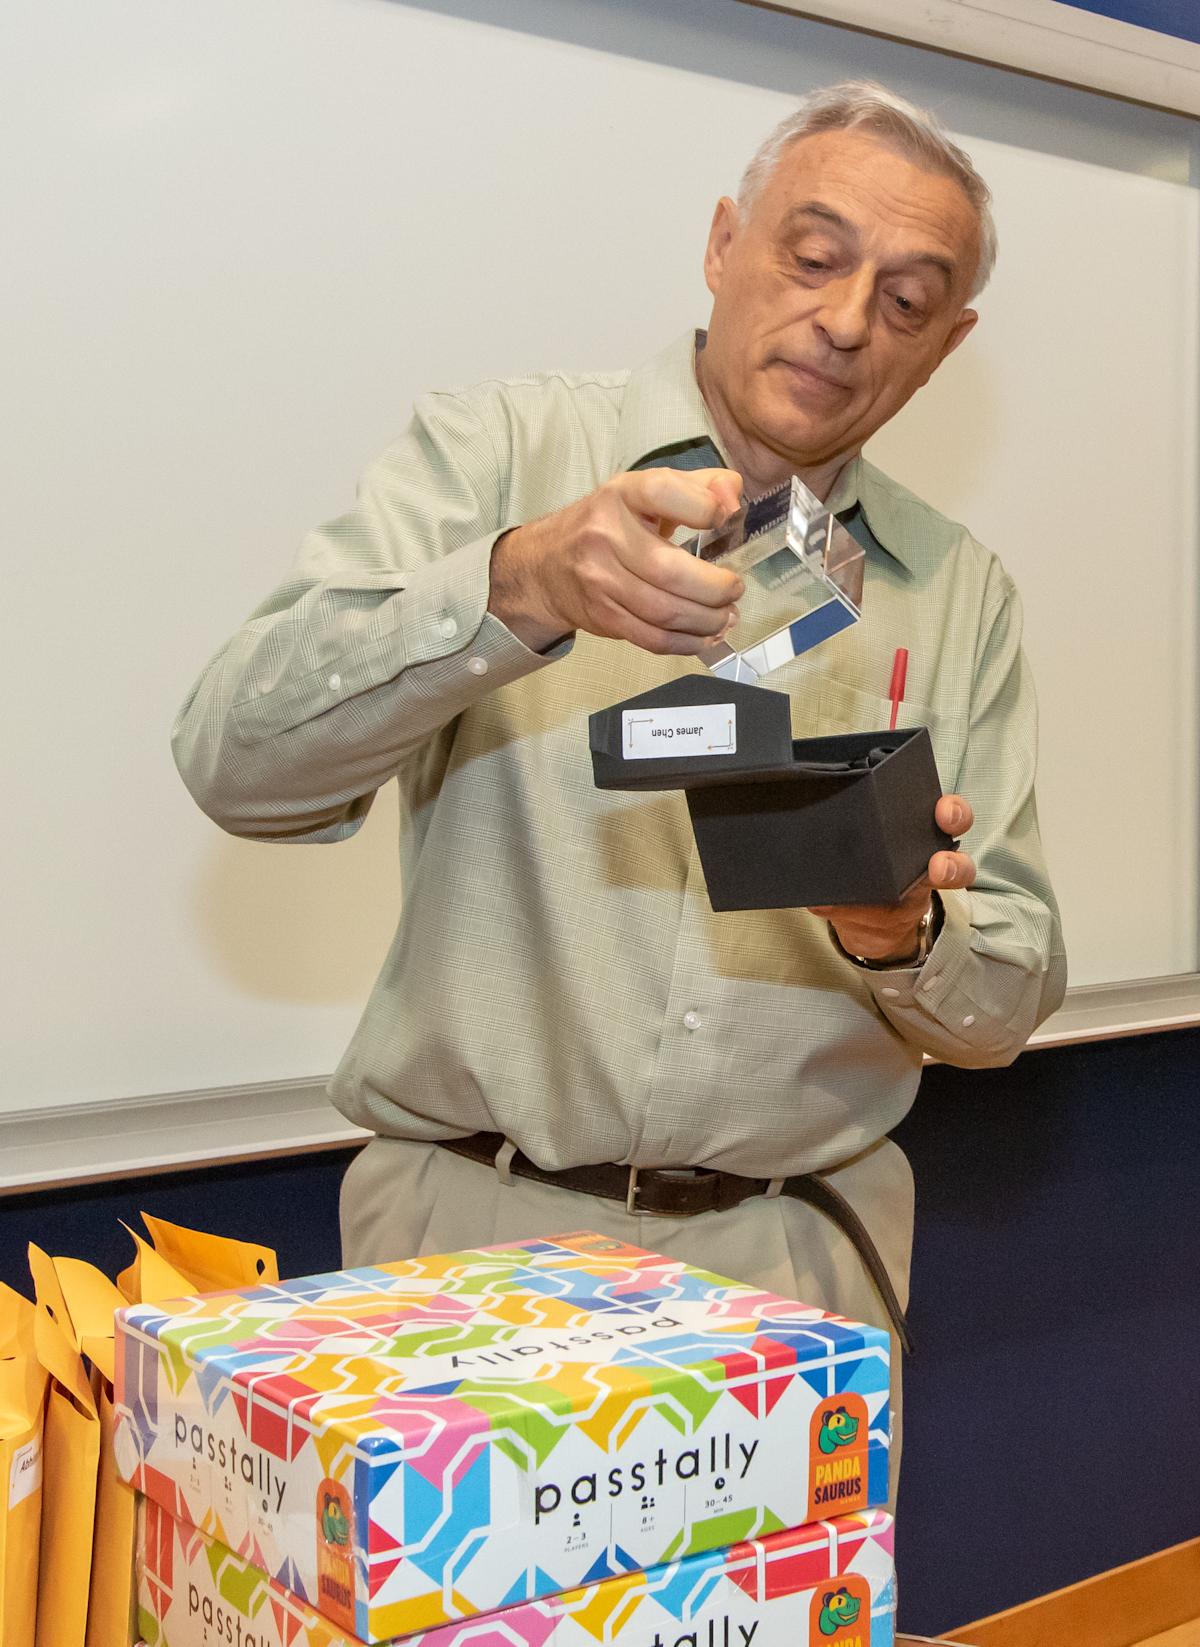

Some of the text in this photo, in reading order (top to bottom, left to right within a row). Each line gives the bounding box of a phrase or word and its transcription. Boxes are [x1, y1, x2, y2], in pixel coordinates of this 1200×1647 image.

[652, 727, 704, 738] James Chen
[452, 1316, 683, 1369] passtally
[175, 1412, 287, 1514] passtally
[535, 1433, 759, 1525] passtally
[816, 1456, 861, 1487] PANDA
[815, 1477, 861, 1504] SAURUS
